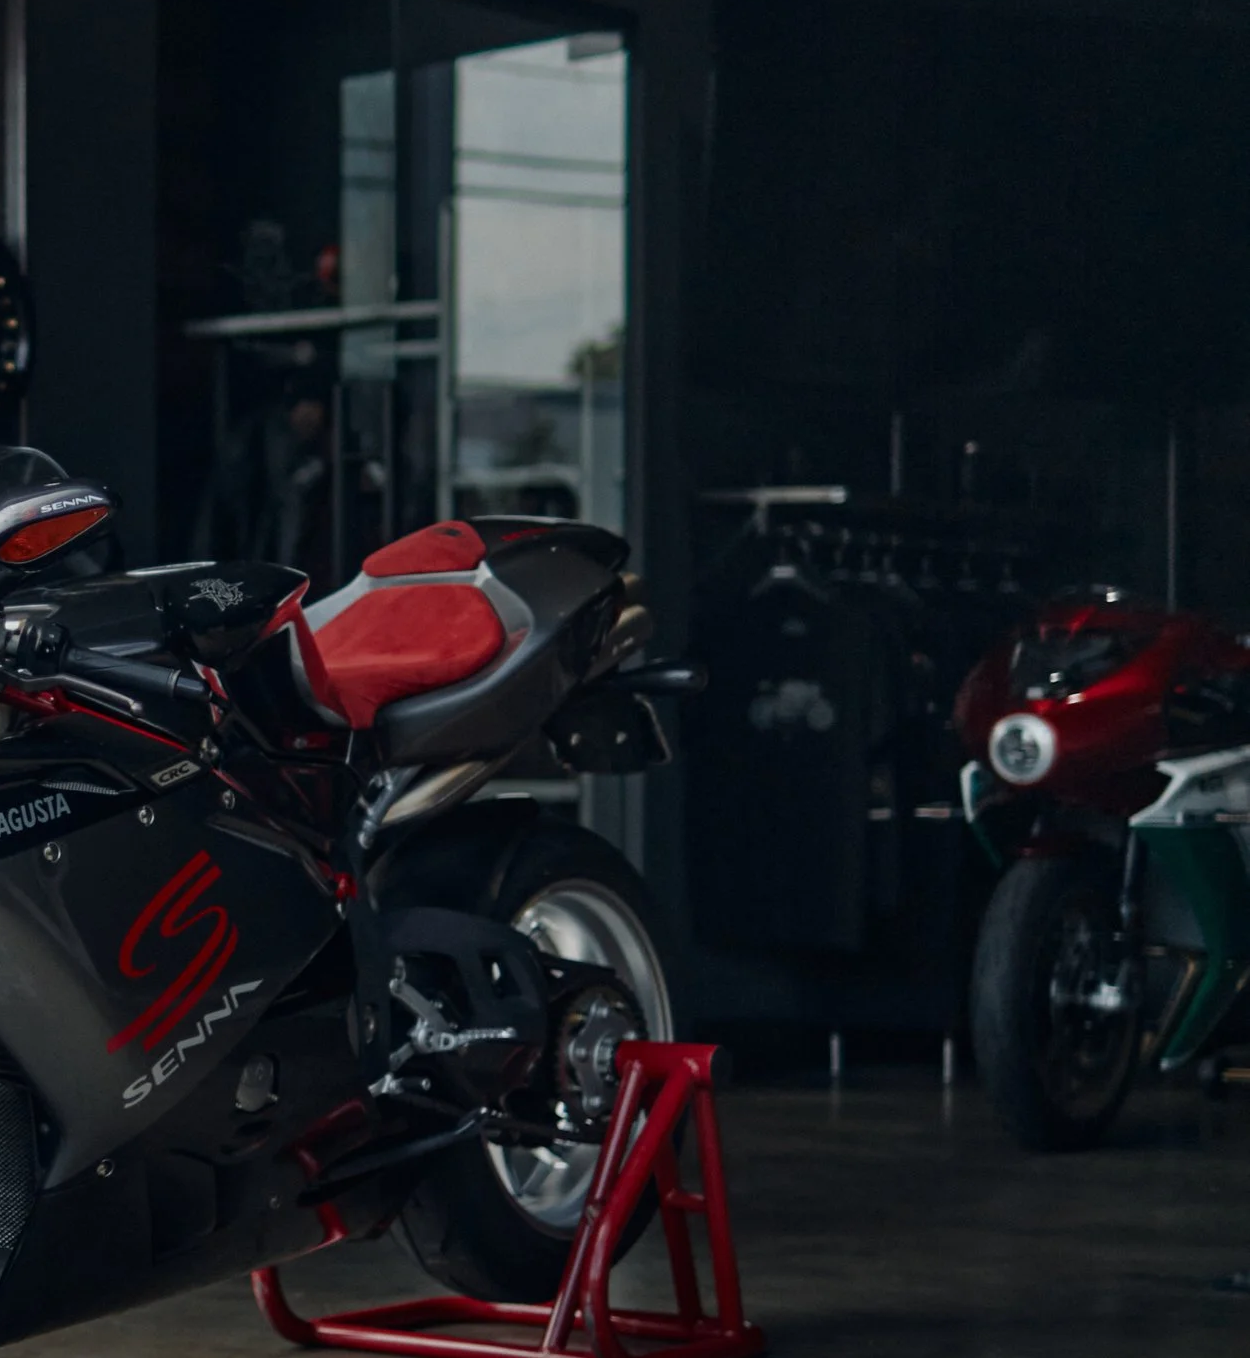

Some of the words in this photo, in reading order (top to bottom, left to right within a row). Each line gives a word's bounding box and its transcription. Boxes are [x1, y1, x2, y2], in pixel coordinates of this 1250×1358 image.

[41, 495, 103, 513] SENNA
[159, 763, 190, 782] CRC
[122, 978, 264, 1109] SENNA
